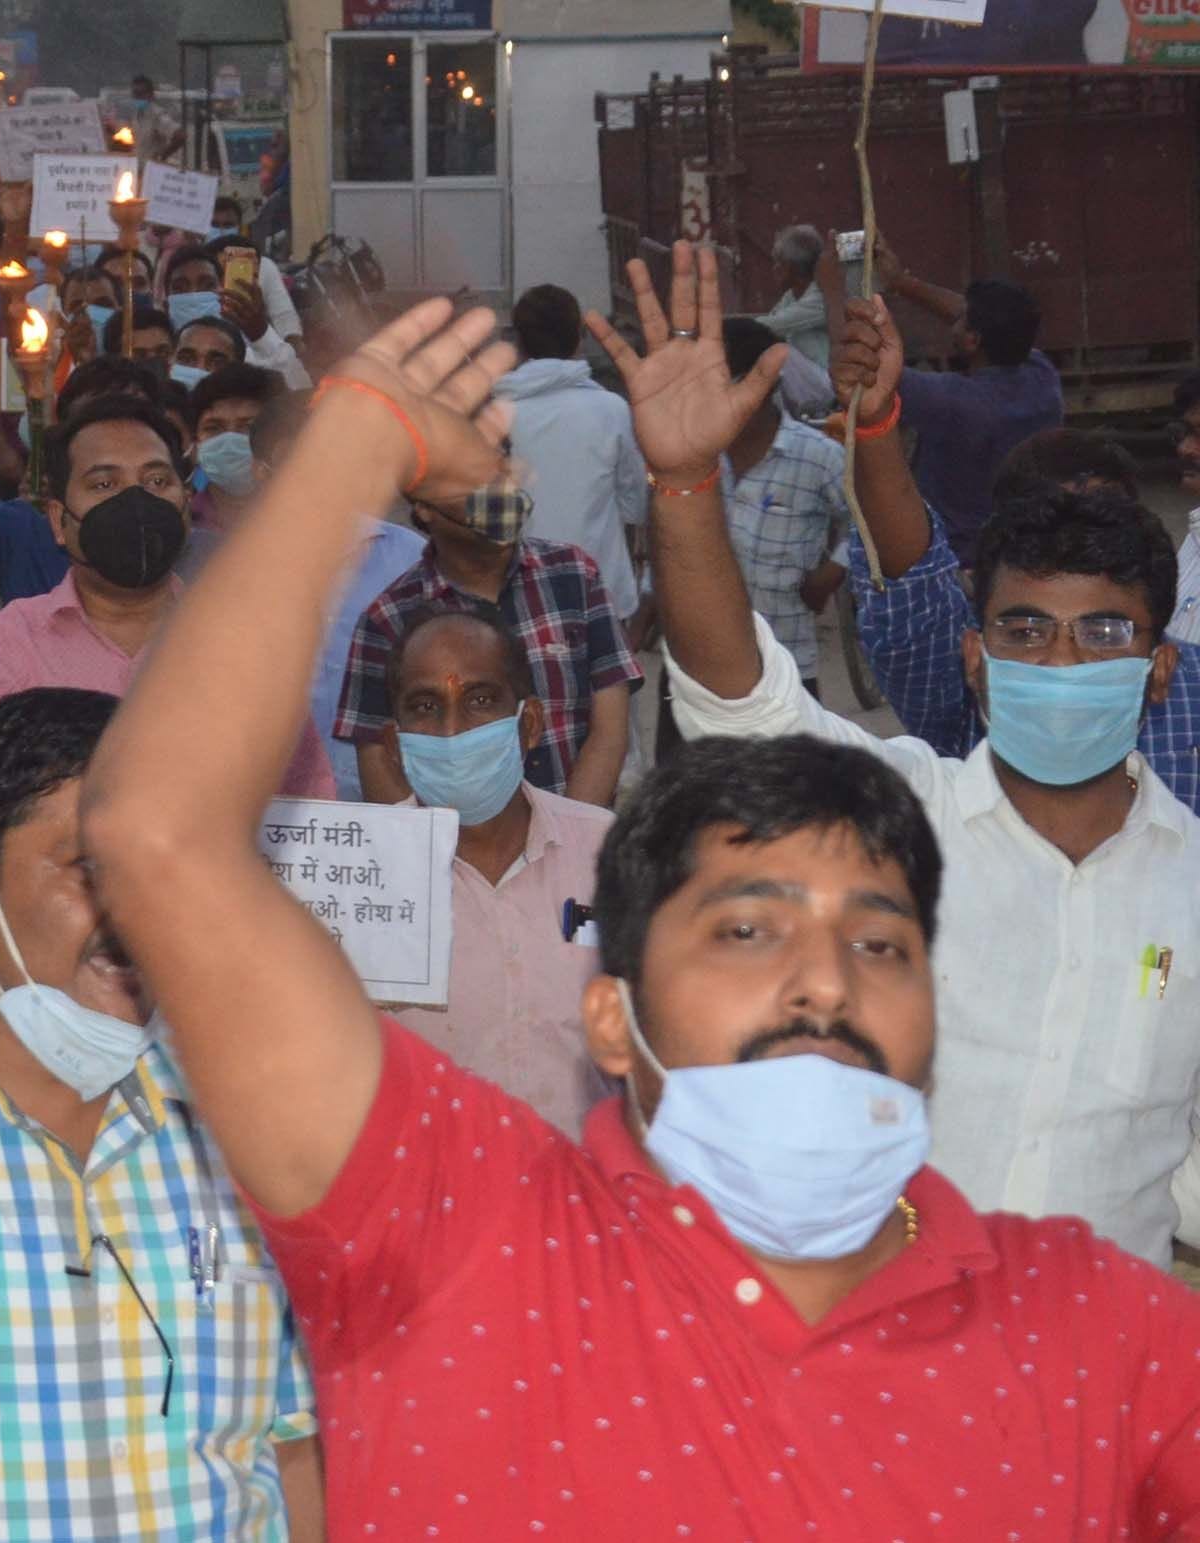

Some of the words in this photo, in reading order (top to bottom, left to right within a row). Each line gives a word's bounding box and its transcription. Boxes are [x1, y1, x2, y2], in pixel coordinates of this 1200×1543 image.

[264, 819, 318, 846] ऊर्जा
[322, 822, 373, 848] मंत्री-
[300, 856, 319, 883] में
[325, 859, 386, 890] आओ,
[353, 896, 393, 924] होश
[399, 898, 416, 924] में
